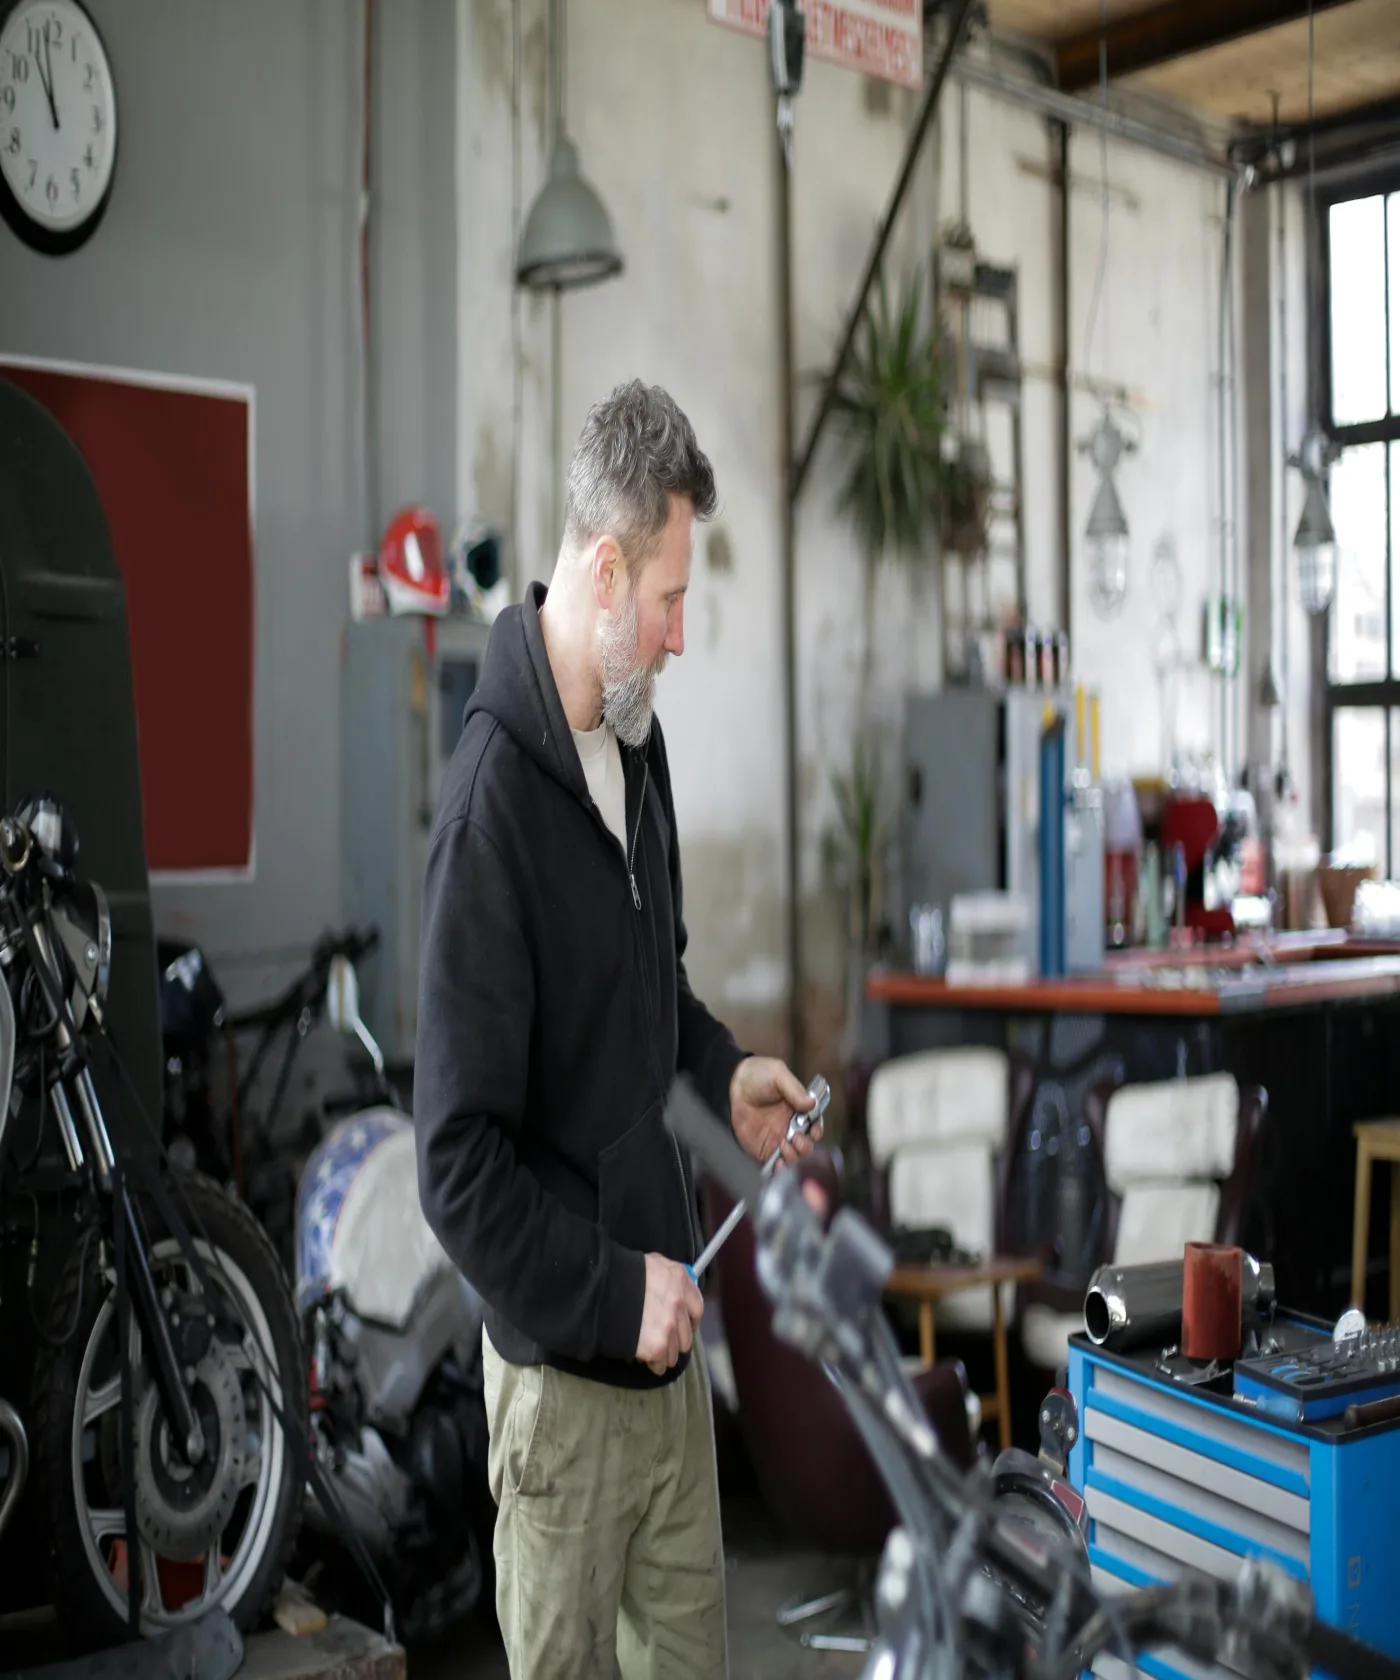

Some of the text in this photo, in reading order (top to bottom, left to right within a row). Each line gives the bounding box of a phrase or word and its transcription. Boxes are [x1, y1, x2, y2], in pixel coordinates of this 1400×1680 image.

[11, 53, 29, 83] 10
[83, 63, 94, 93] 2
[4, 84, 16, 115] 9
[9, 126, 21, 155] 8
[27, 158, 38, 188] 7
[45, 174, 59, 203] 6
